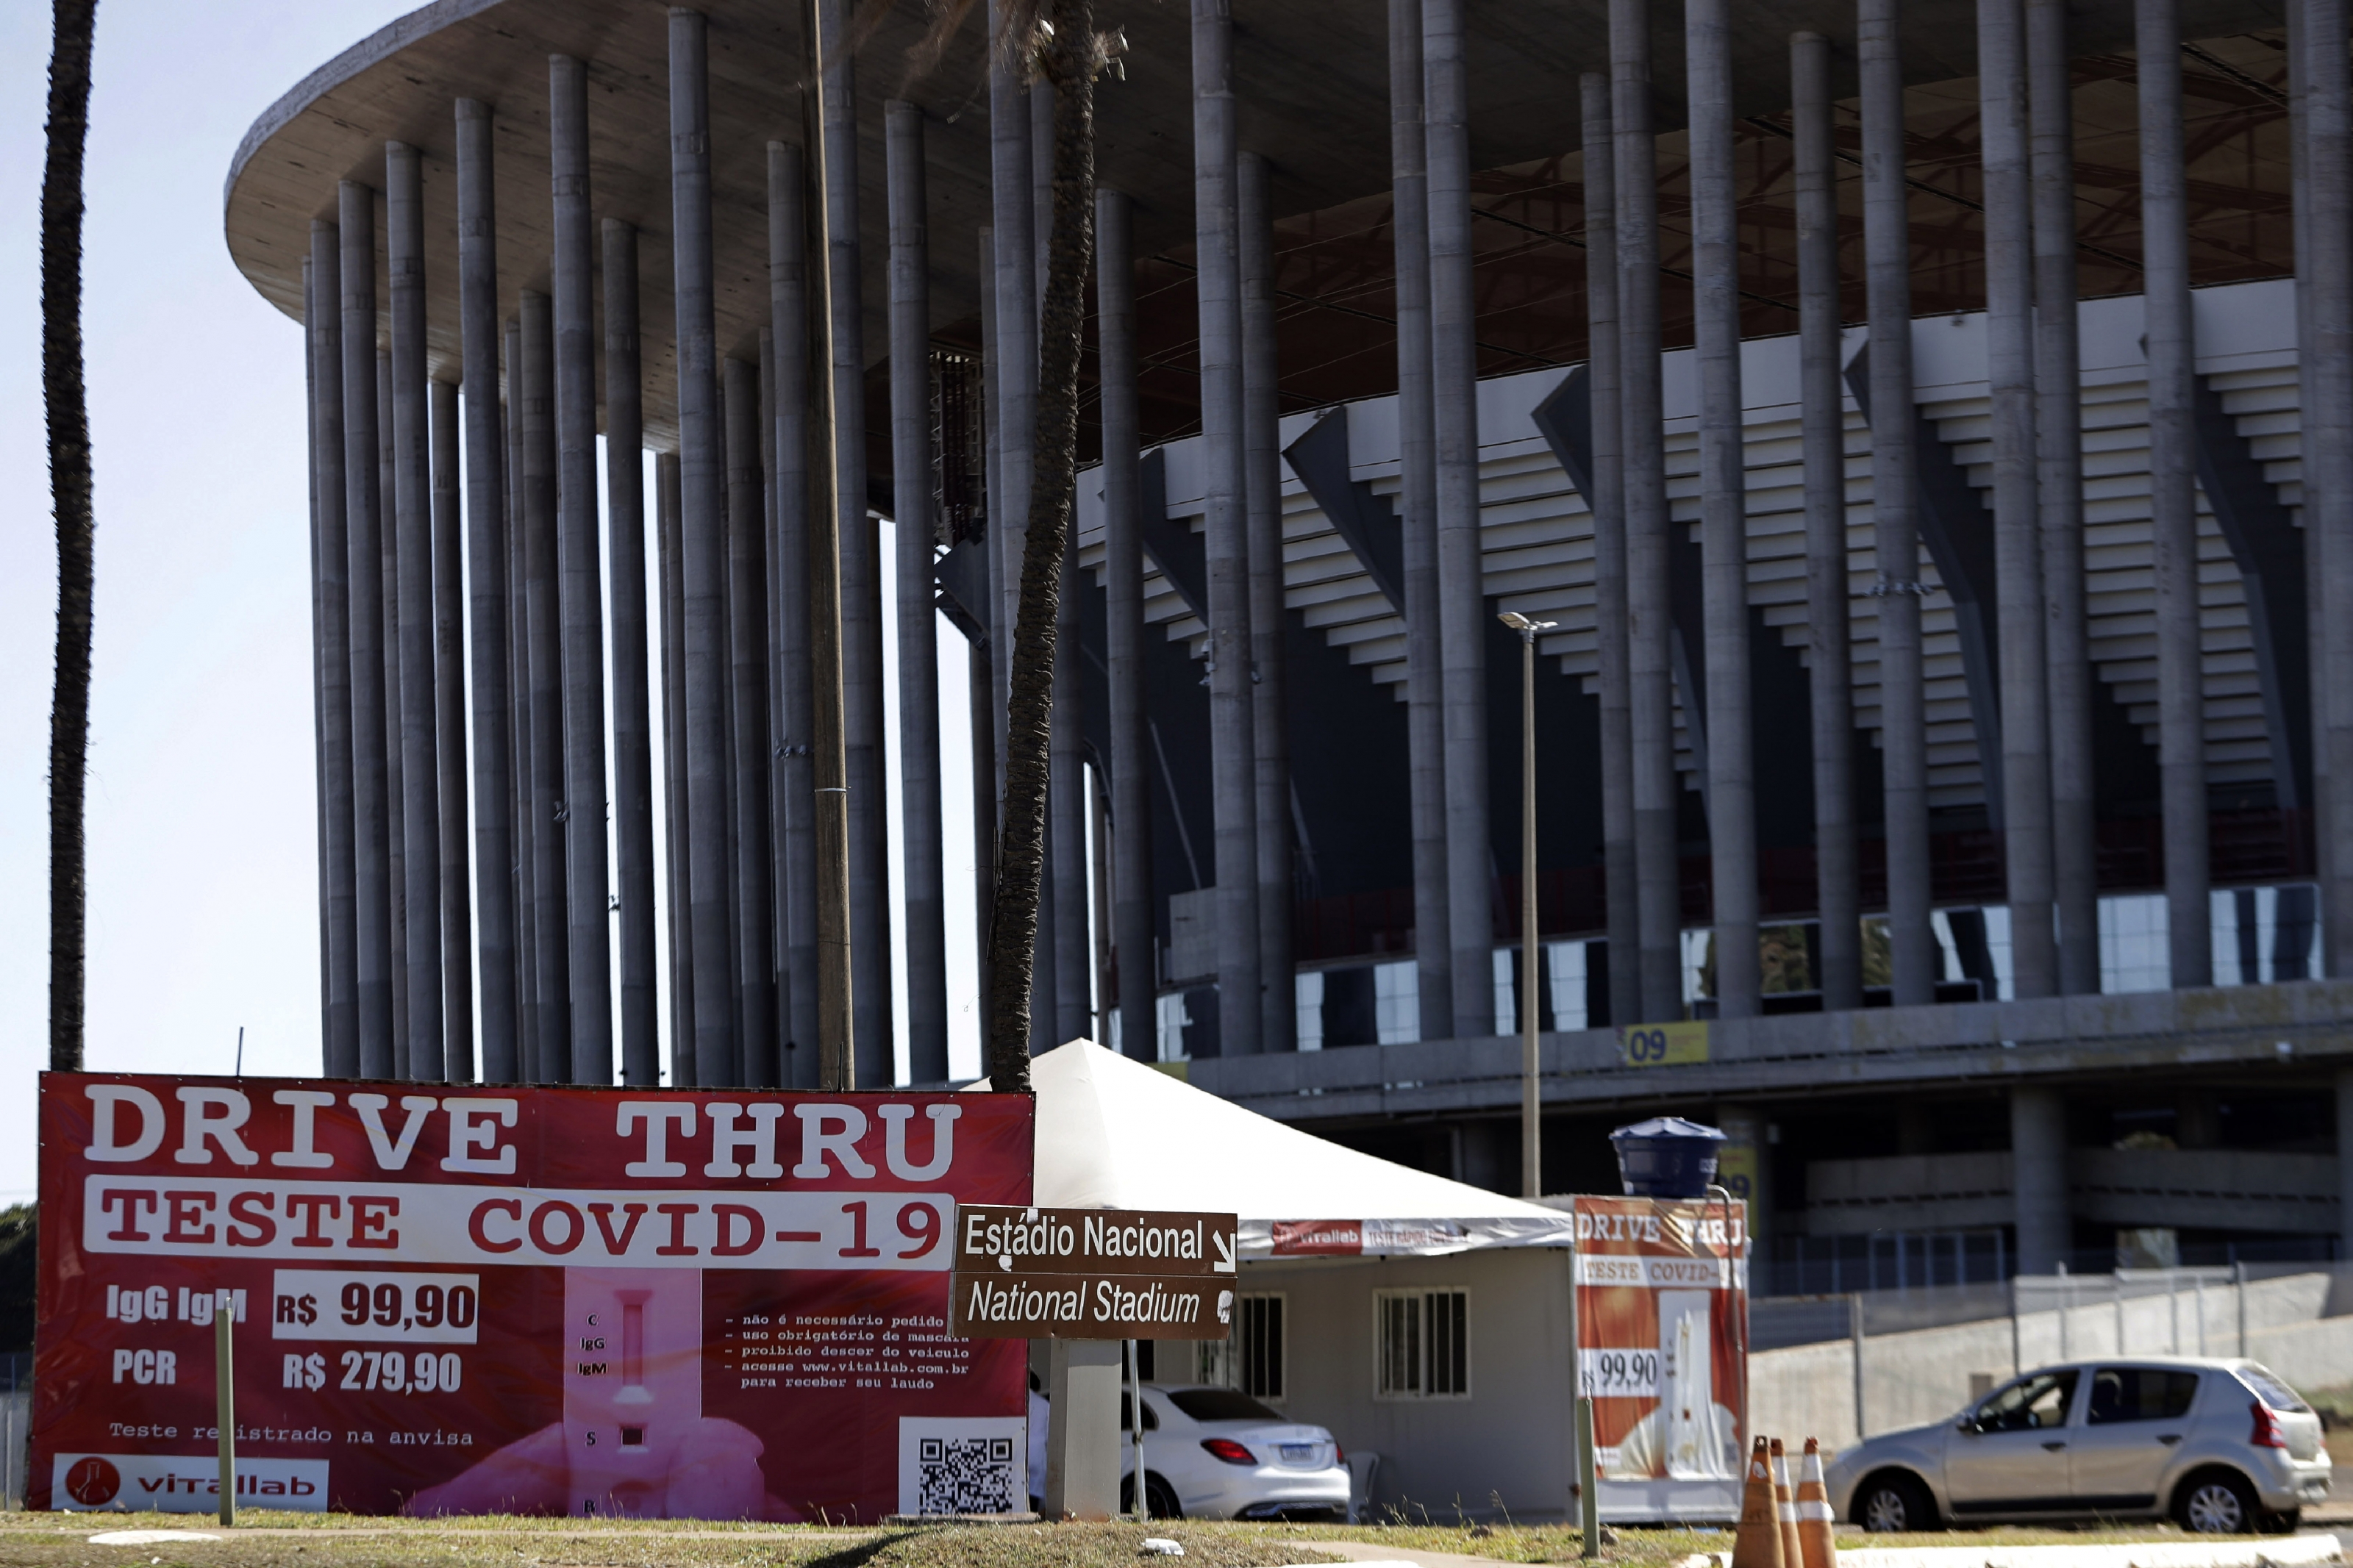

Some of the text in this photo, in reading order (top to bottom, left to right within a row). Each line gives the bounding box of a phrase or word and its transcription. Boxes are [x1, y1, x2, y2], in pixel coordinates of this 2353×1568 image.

[1631, 1029, 1665, 1062] 09
[84, 1084, 962, 1181] DRIVE THRU
[101, 1189, 941, 1259] TESTE COVID-19
[965, 1212, 1203, 1259] Estádio Nacional
[1577, 1214, 1661, 1242] DRIVE
[1586, 1261, 1639, 1280] TESTE
[107, 1285, 246, 1325] IgG IgM
[276, 1282, 475, 1331] R$ 99,90
[968, 1280, 1199, 1323] National Stadium
[588, 1314, 598, 1325] C
[743, 1315, 768, 1325] não
[778, 1314, 787, 1325] é
[796, 1314, 883, 1325] necessário
[891, 1317, 944, 1328] pedido
[580, 1337, 605, 1350] IgG
[743, 1331, 768, 1339] uso
[778, 1330, 874, 1342] obrigatório
[882, 1331, 899, 1341] de
[741, 1345, 812, 1357] proibido
[821, 1345, 874, 1356] descer
[882, 1347, 899, 1357] do
[113, 1349, 176, 1384] PCR
[283, 1350, 462, 1396] R$ 279,90
[578, 1361, 607, 1375] IgM
[741, 1362, 793, 1372] acesse
[802, 1361, 968, 1374] www.vitallab.com.br
[1601, 1353, 1657, 1390] 99,90
[741, 1377, 934, 1389] para receber seu laudo
[110, 1422, 473, 1445] Teste reistrado na anvisa
[586, 1431, 596, 1445] S
